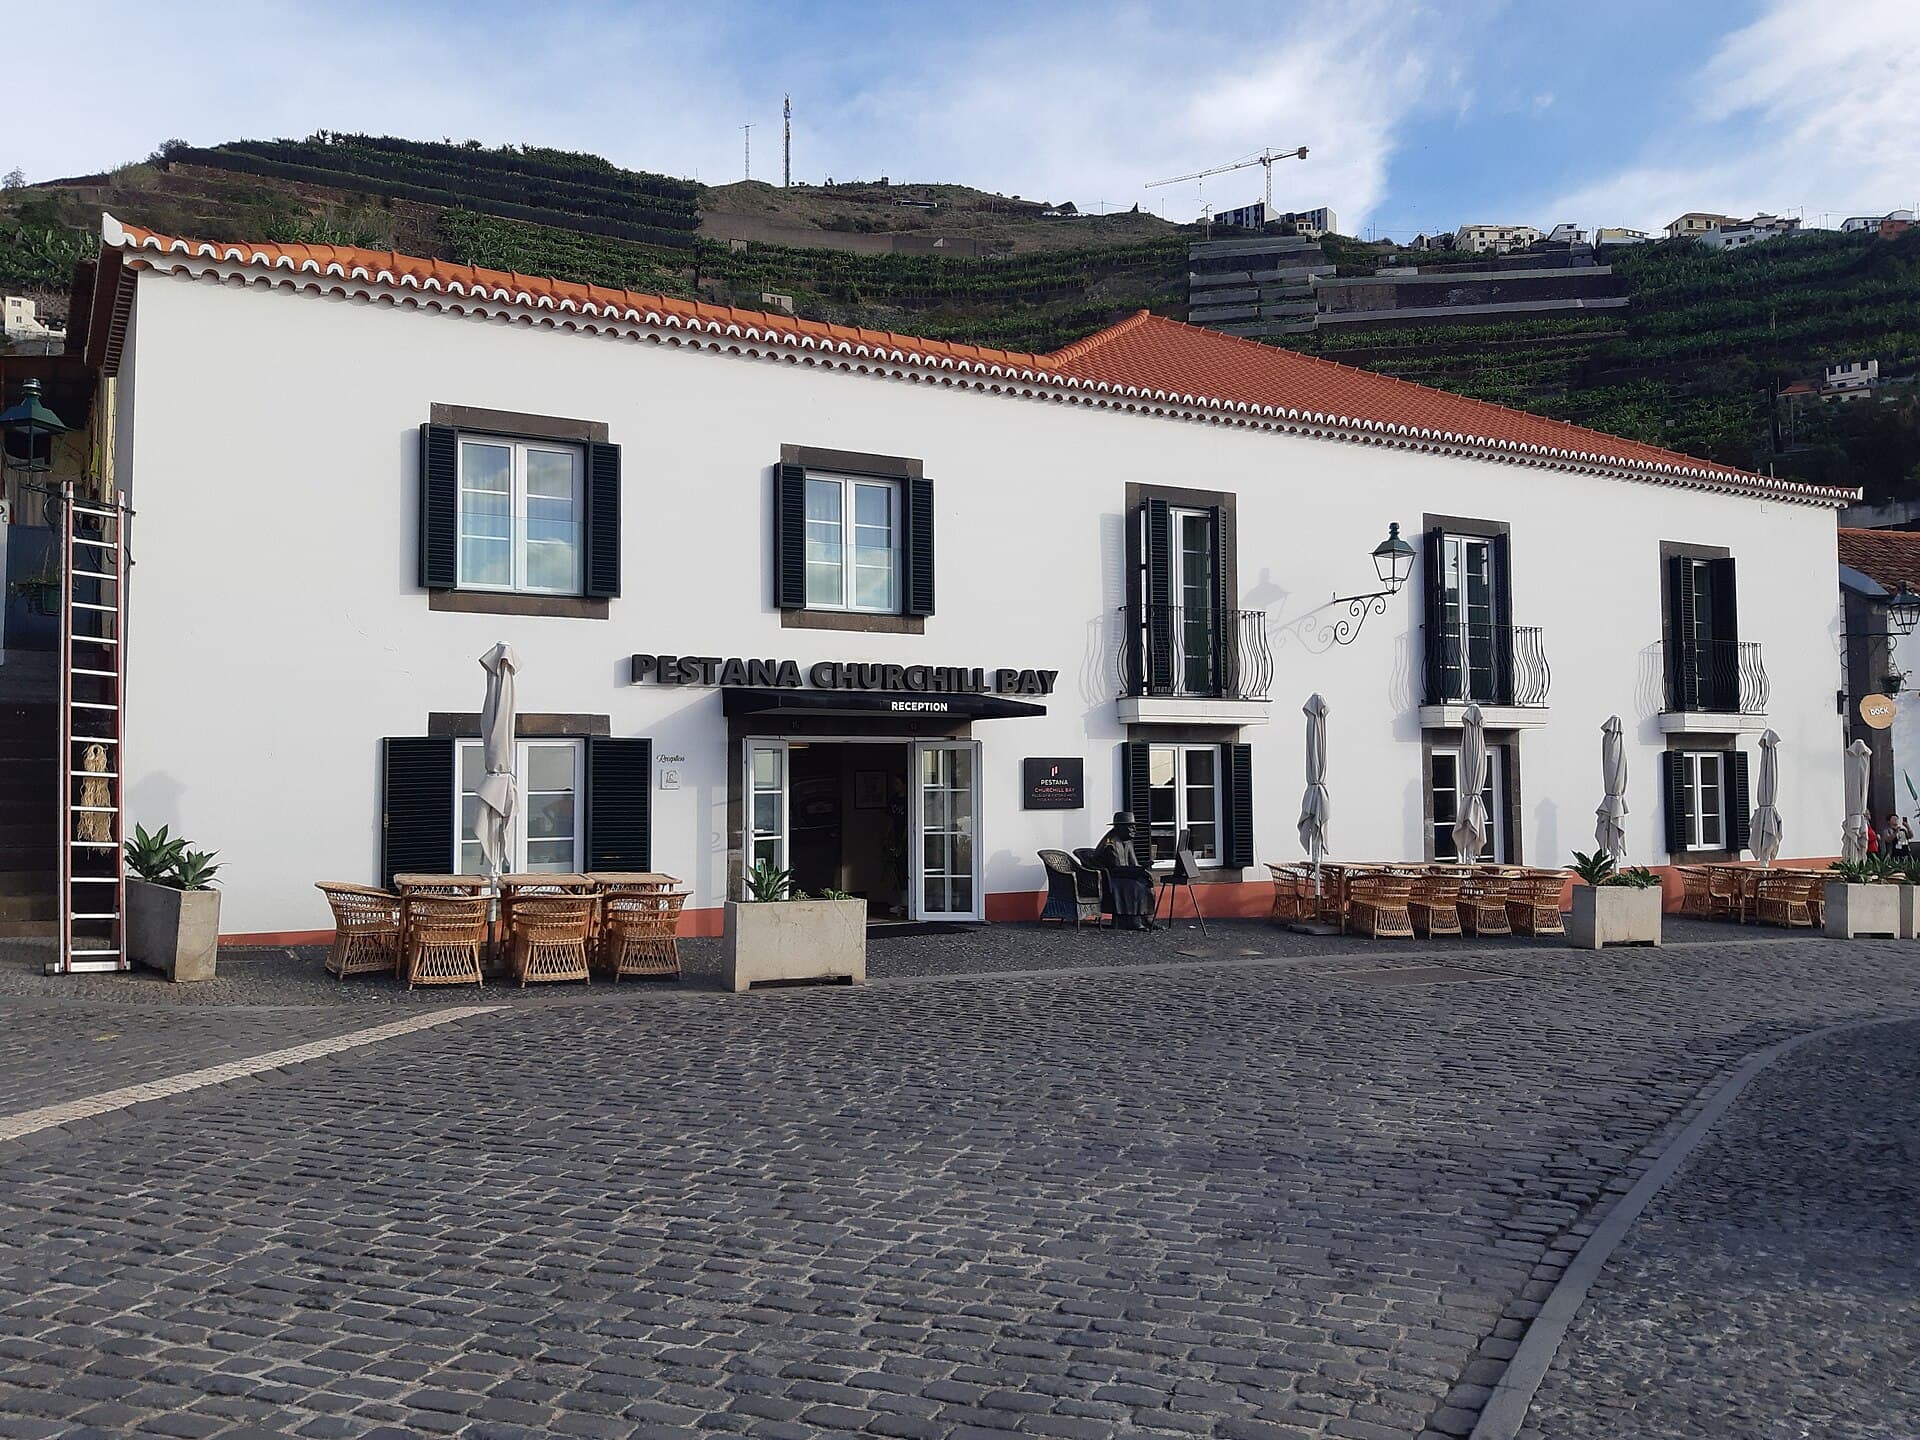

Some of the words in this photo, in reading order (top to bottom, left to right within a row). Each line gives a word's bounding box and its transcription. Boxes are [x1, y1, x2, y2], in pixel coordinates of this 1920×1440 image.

[631, 654, 803, 687] PESTANA
[810, 662, 990, 693] CHURCHILL
[996, 668, 1059, 694] BAY
[891, 701, 948, 711] RECEPTION
